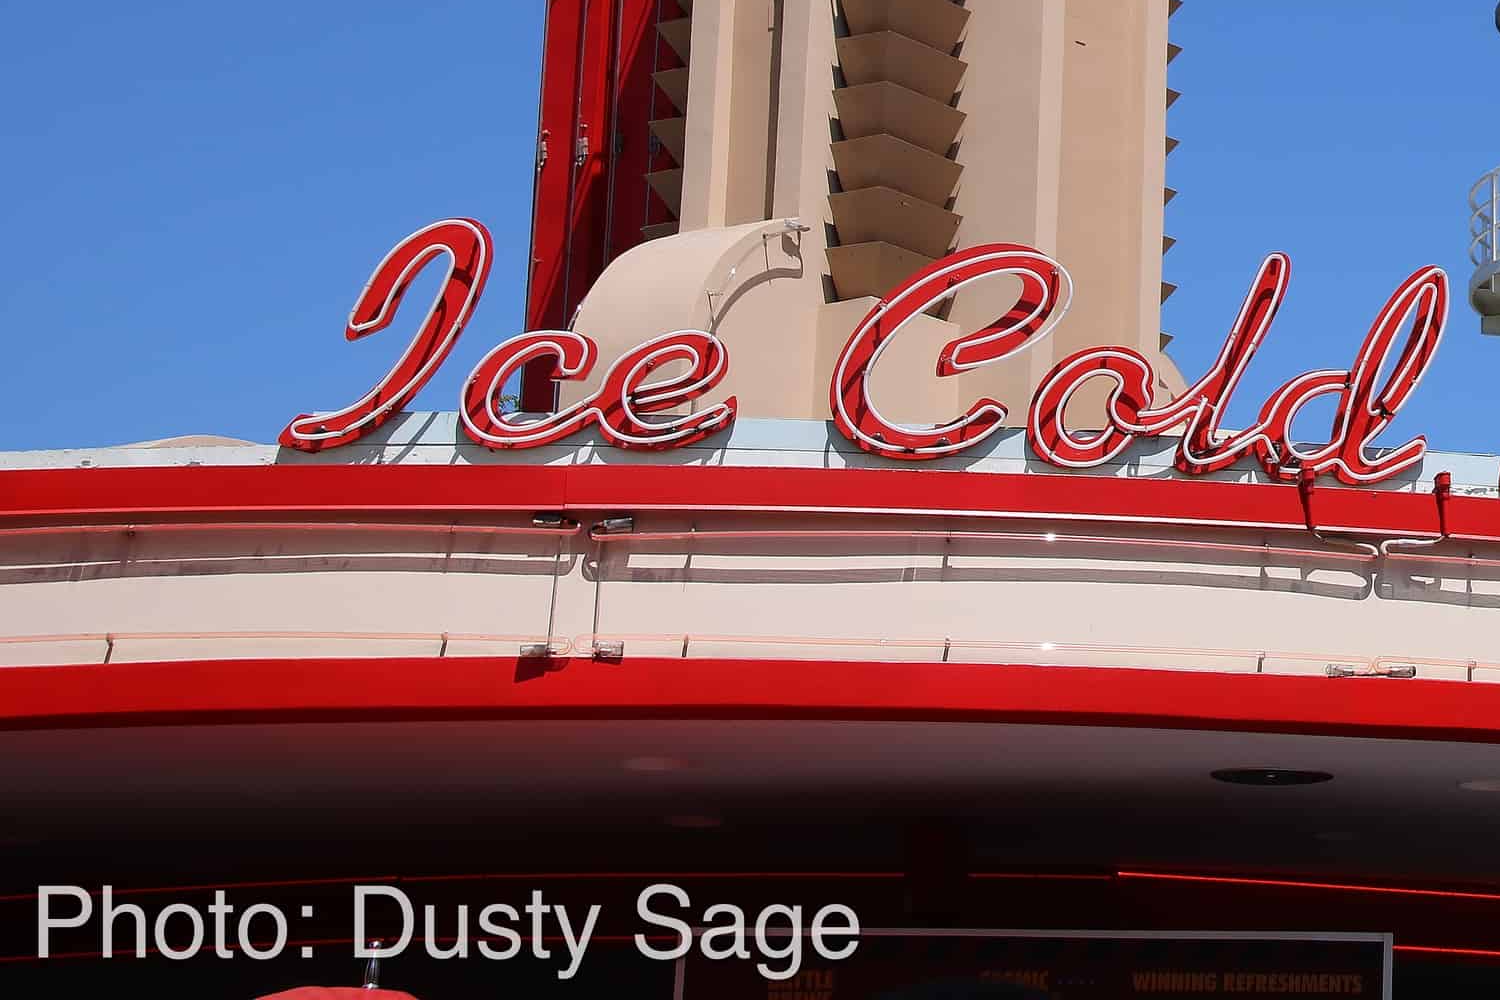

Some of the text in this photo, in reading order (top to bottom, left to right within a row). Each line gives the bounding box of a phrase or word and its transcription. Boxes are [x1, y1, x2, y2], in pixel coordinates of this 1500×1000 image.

[278, 217, 737, 453] Ice
[830, 243, 1449, 486] Cold
[1134, 972, 1362, 993] WINNING REFRESHMENTS
